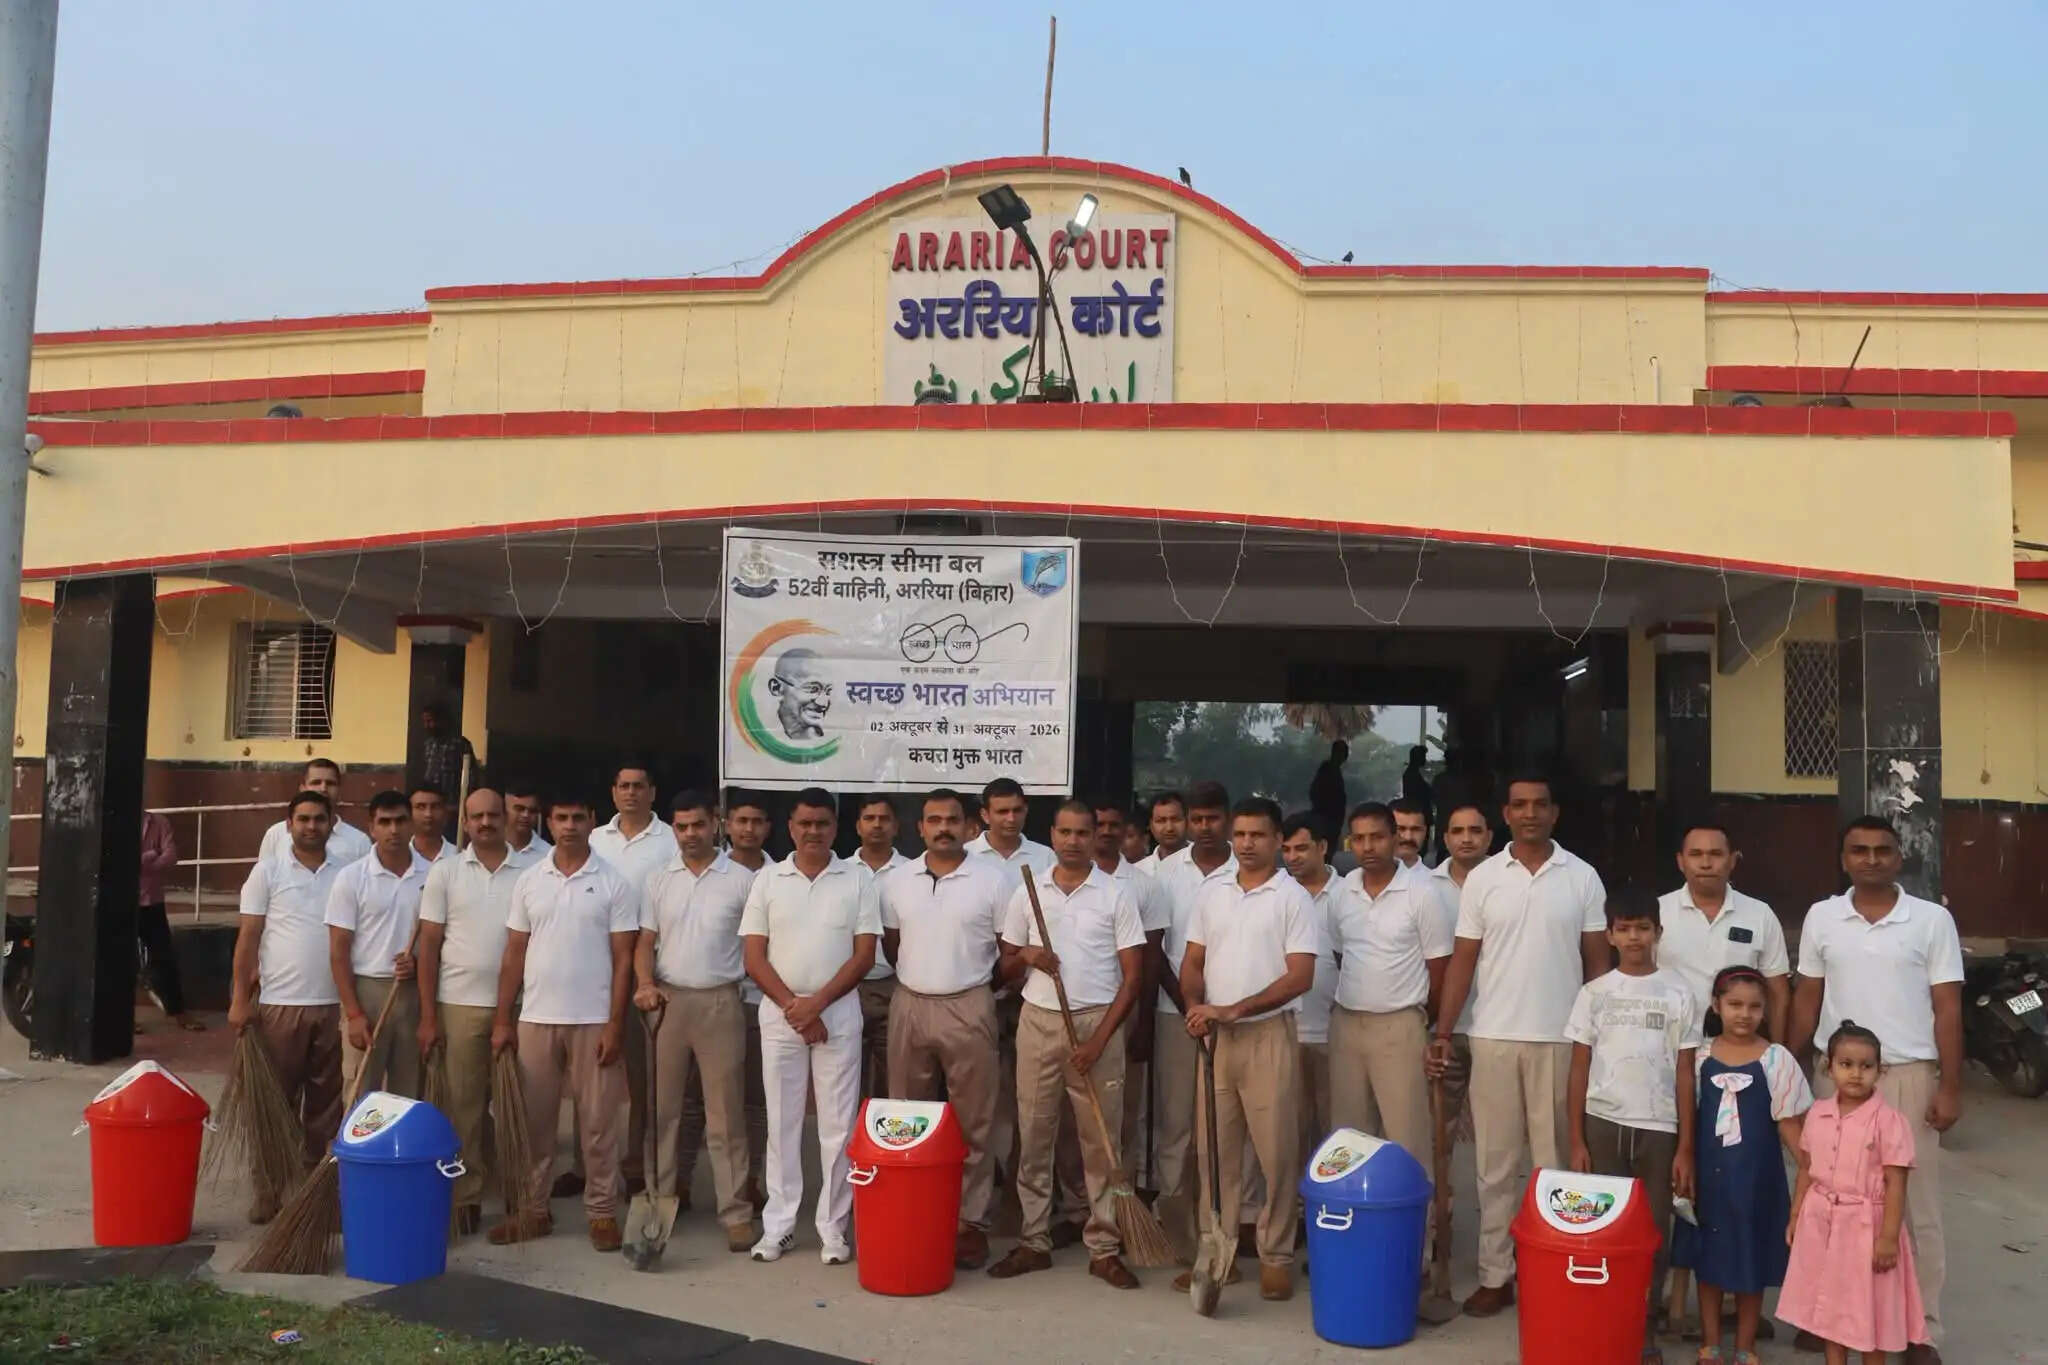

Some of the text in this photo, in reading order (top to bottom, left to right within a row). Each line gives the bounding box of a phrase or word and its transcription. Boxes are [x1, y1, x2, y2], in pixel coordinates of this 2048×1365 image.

[892, 229, 1169, 271] ARARIA COURT
[894, 278, 1164, 340] अररिय कोर्ट
[817, 547, 985, 574] सशस्त्र सीमा बल
[788, 575, 1014, 604] 52वीं वाहिनी, अररिया (बिहार)
[846, 681, 1056, 707] स्वच्छ भारत अभियान
[870, 716, 1061, 740] 02 अक्टूबर से 31 अक्टूबर 2026
[908, 748, 1024, 769] कचरा मुक्त भारत
